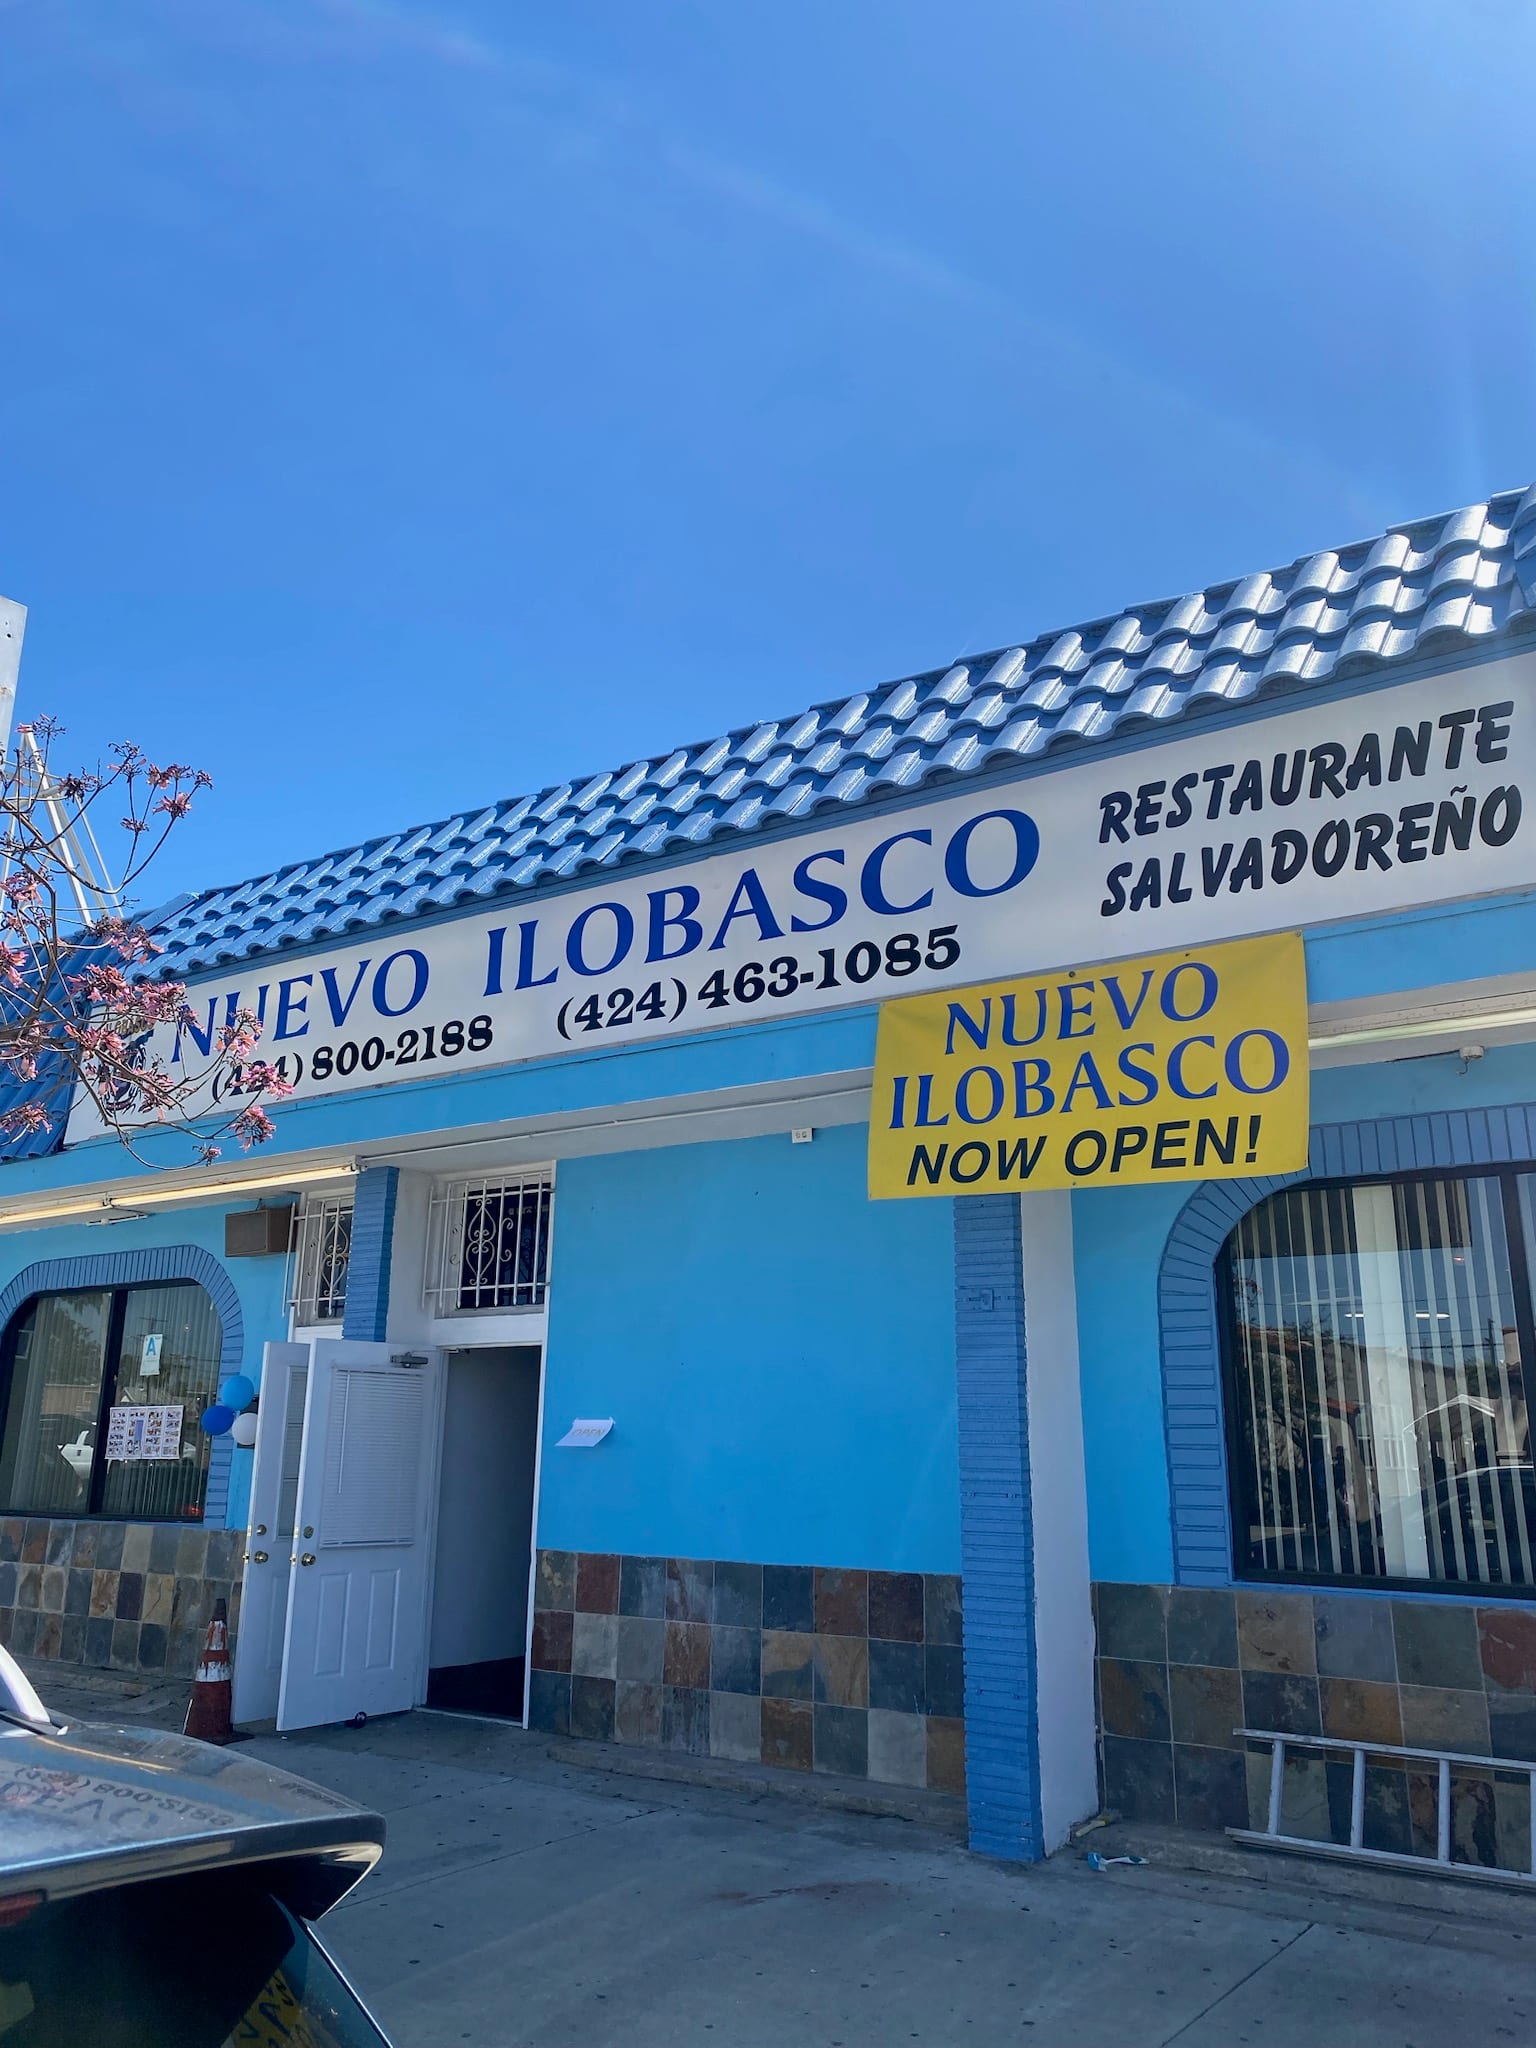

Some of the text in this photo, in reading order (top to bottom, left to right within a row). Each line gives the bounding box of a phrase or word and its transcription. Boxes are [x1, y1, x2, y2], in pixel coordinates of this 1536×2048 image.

[1099, 700, 1515, 844] RESTAURANTE
[1100, 784, 1523, 917] SALVADOREÑO
[170, 808, 1041, 1064] NUEVO ILOBASCO
[556, 925, 961, 1041] (424) 463-1085
[311, 1015, 493, 1081] 800-2188
[944, 961, 1219, 1056] NUEVO
[888, 1028, 1290, 1129] ILOBASCO
[906, 1114, 1262, 1186] NOW OPEN!
[145, 1337, 157, 1357] A
